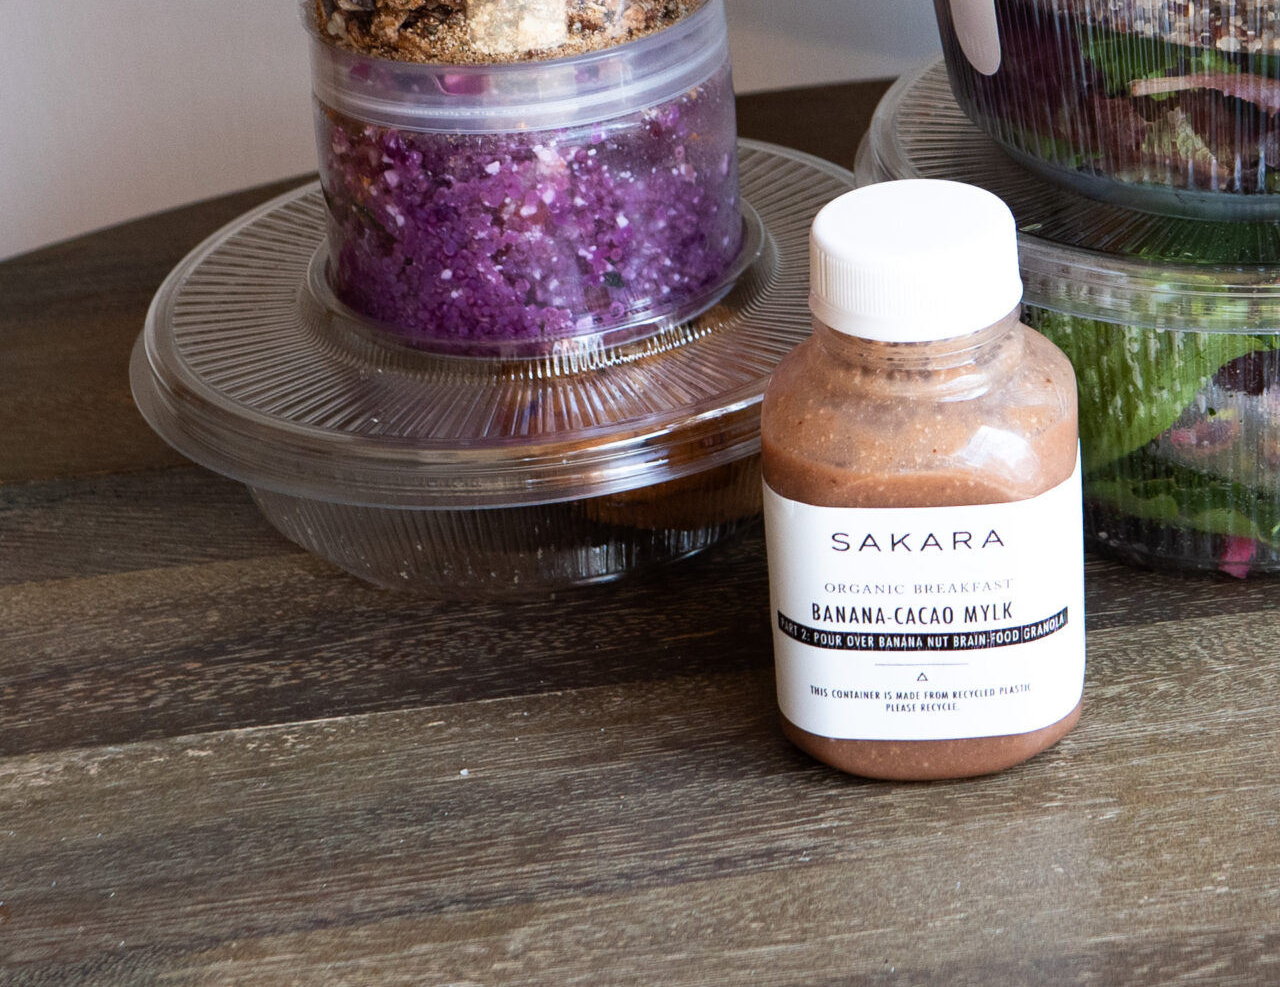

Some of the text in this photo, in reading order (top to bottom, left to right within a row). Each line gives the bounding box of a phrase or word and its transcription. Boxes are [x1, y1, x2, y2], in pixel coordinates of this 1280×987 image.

[831, 529, 1005, 552] SAKARA
[824, 578, 1013, 595] ORGANIC BREAKFAST
[811, 601, 1013, 625] BANANA-CACAO MYLK
[780, 614, 1065, 648] PART 2: POUR OVER BANANA NUT BRAIN-FOOD GRANOLA
[810, 683, 1032, 700] THIS CONTAINER IS MADE FROM RECYCLED PLASTIC
[885, 703, 916, 713] PLEASE
